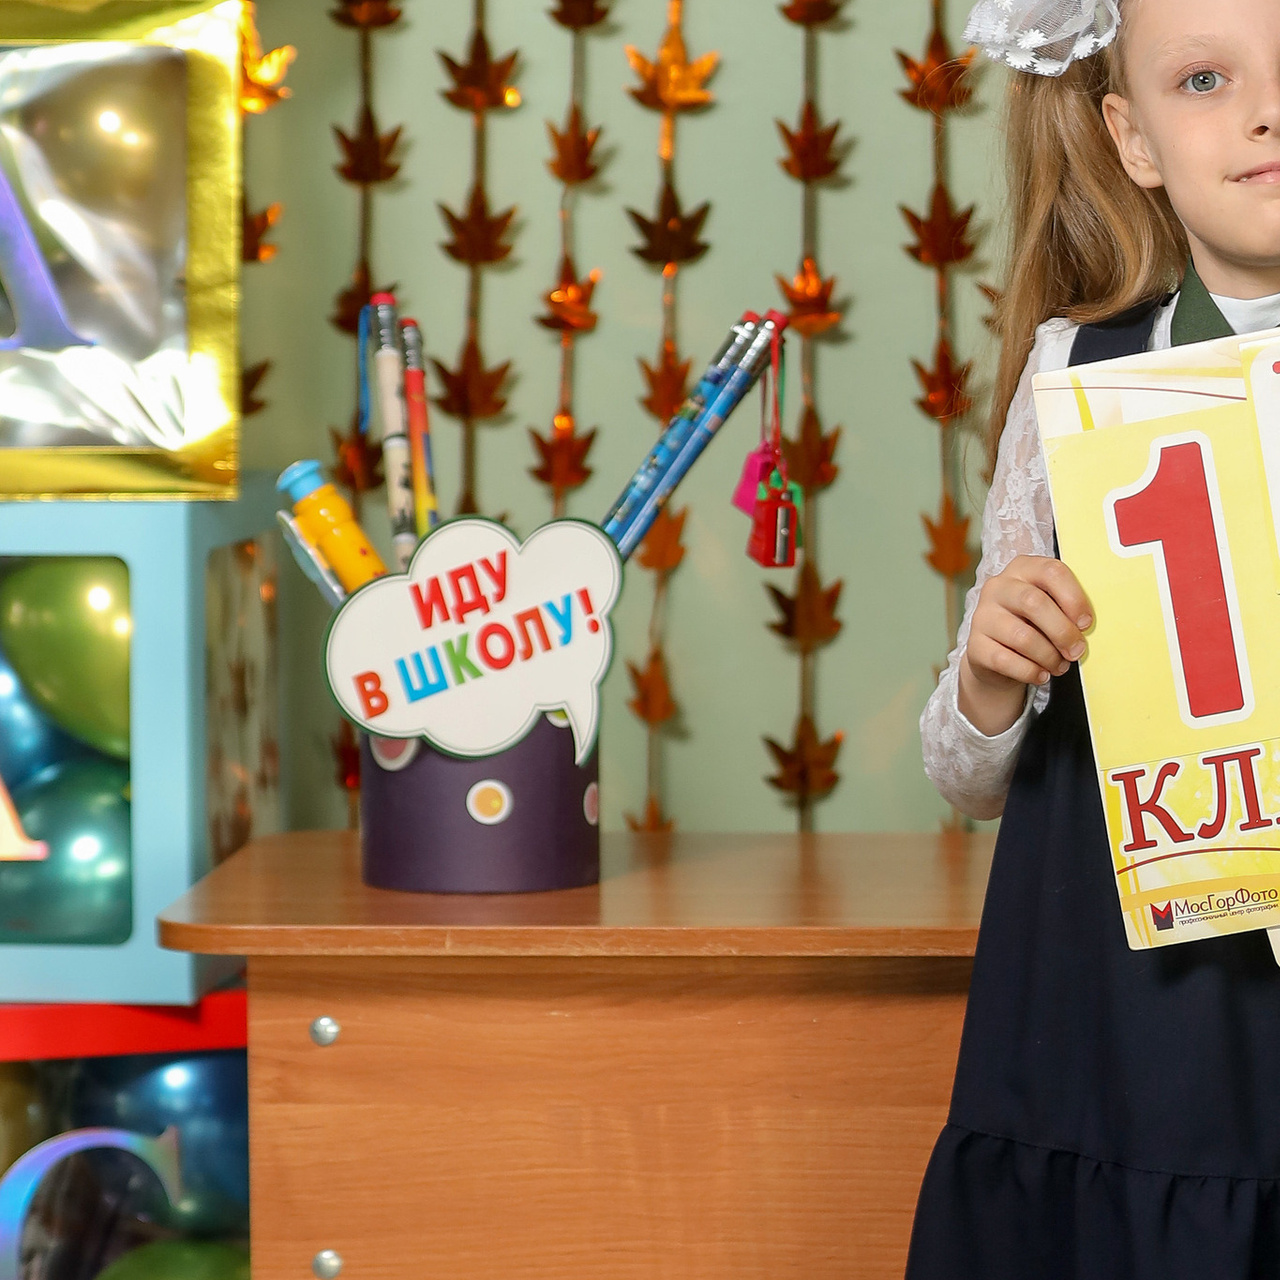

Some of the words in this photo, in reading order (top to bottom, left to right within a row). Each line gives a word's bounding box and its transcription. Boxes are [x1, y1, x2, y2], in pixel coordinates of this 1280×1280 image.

[409, 551, 508, 630] ИДУ
[1113, 441, 1245, 718] 1
[352, 669, 390, 721] В
[395, 587, 600, 704] ШКОЛУ!
[1174, 887, 1279, 917] МосГорФото
[1178, 911, 1229, 926] профессиональный
[1229, 908, 1245, 917] центр
[1245, 902, 1279, 915] фотографии
